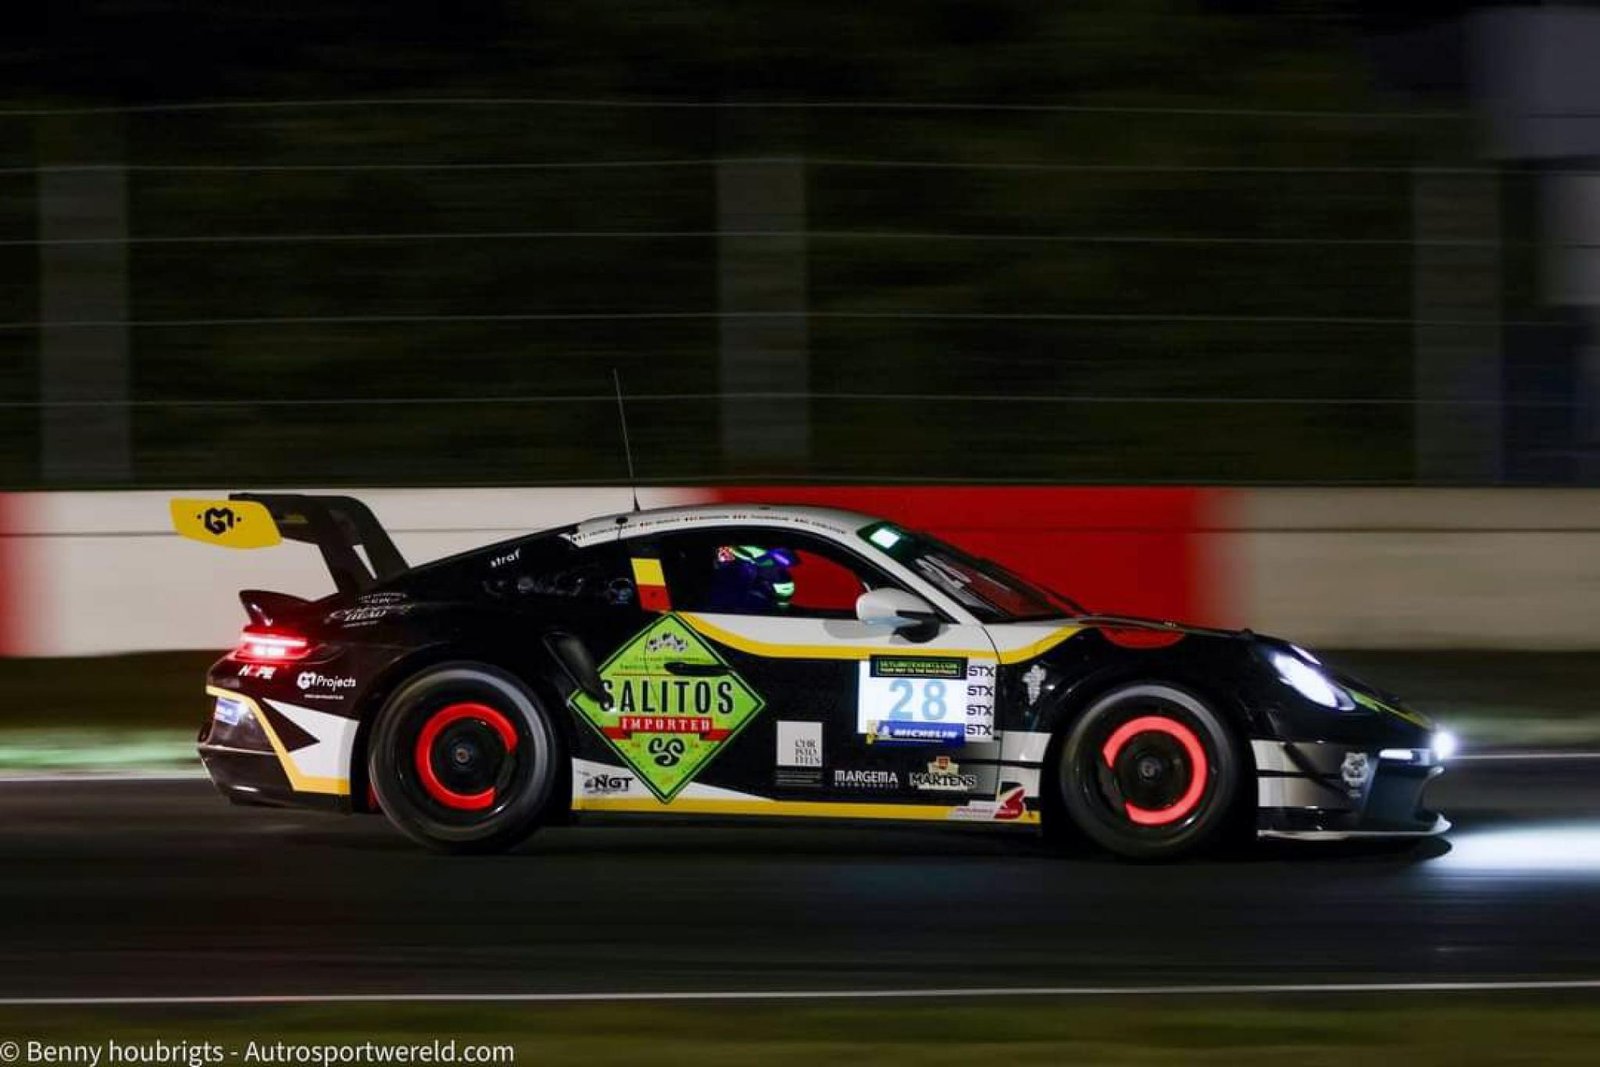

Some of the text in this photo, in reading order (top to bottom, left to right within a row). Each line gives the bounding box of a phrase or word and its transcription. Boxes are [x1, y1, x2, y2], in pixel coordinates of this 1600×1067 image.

[969, 665, 994, 676] STX
[317, 674, 356, 691] Projects
[600, 679, 733, 714] SALITOS
[967, 685, 993, 696] STX
[889, 679, 947, 720] 28
[966, 705, 992, 715] STX
[621, 719, 712, 731] IMPORTED
[966, 724, 991, 735] STX
[892, 728, 958, 738] MICHELIN
[834, 769, 898, 784] MARGEMA
[909, 771, 976, 787] MARTENS
